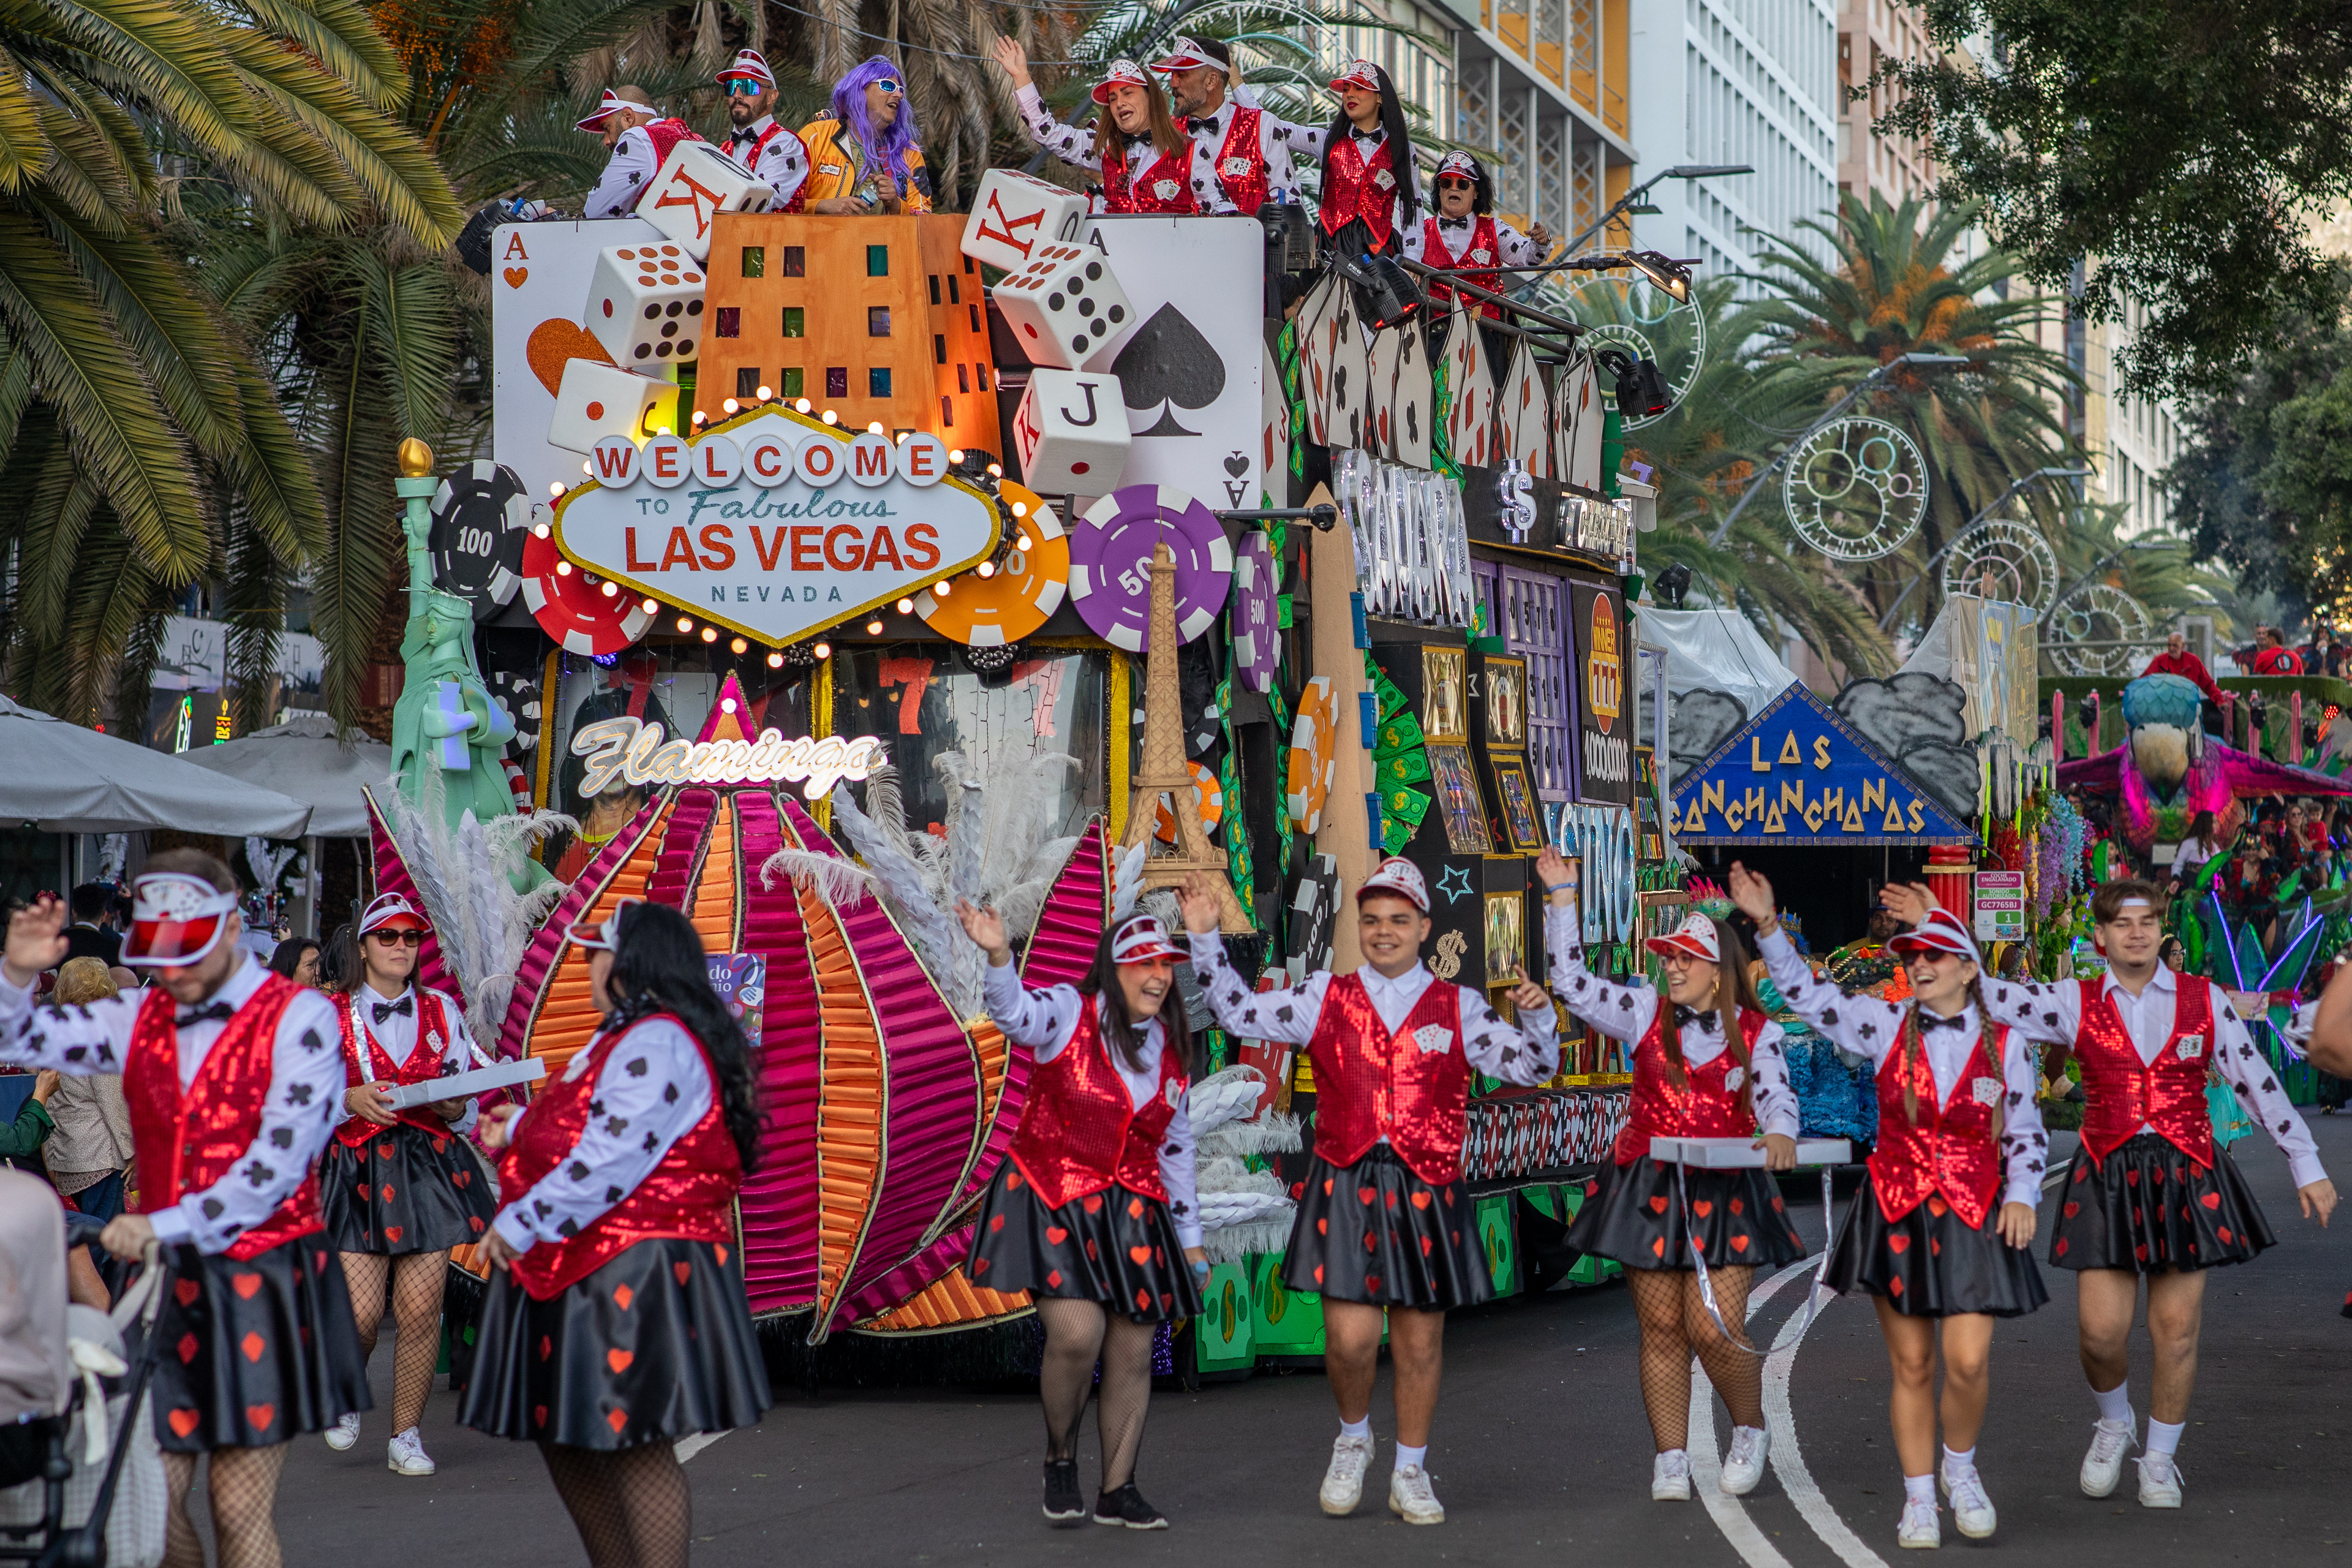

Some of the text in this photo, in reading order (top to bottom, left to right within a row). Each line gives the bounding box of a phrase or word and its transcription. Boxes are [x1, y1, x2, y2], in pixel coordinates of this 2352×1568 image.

[654, 164, 727, 239] K
[976, 188, 1046, 260] K
[1088, 228, 1109, 256] A
[503, 232, 529, 260] A
[1061, 382, 1098, 426] J
[1019, 389, 1040, 468] K
[595, 445, 934, 478] WELCOME
[636, 488, 898, 526] TO Fabulous
[1223, 480, 1250, 509] A
[457, 526, 493, 557] 100
[625, 524, 941, 572] LAS VEGAS
[1118, 543, 1177, 597] 50
[711, 586, 843, 602] NEVADA
[1251, 598, 1265, 625] 500
[1593, 625, 1615, 654] WINNER
[879, 657, 935, 735] 7
[572, 717, 888, 800] Flamingo
[1752, 729, 1832, 772] LAS
[1668, 777, 1926, 837] CANCHANCHANAS
[1307, 905, 1322, 960] 100
[2005, 913, 2012, 923] 1
